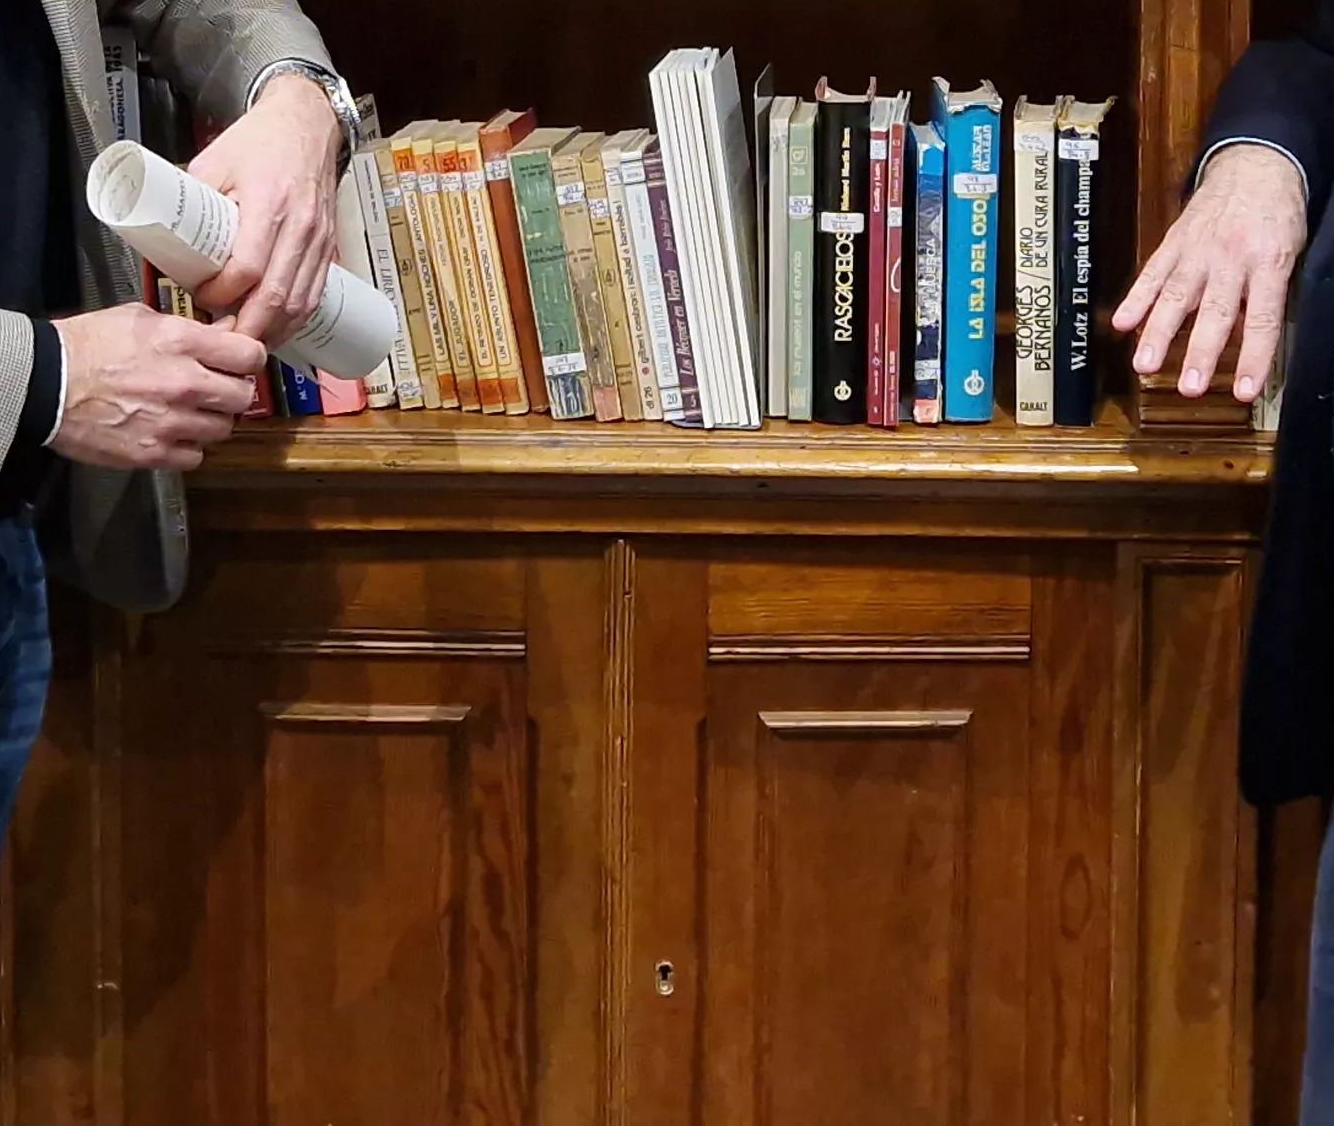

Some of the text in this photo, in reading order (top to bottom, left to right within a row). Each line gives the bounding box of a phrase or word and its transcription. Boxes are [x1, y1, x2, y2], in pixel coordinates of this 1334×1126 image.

[1074, 159, 1092, 216] champa
[1074, 218, 1090, 242] del
[414, 247, 431, 288] NOCHES
[968, 198, 987, 339] LA ISLA DEL OSO
[1033, 151, 1051, 371] BERNANOS DE UN CURA RURAL
[1073, 244, 1092, 283] espía
[422, 288, 436, 311] UNA
[1015, 226, 1033, 359] GEORGES DIARIO
[1073, 287, 1088, 304] El
[426, 309, 437, 319] Y
[428, 319, 441, 336] MIL
[431, 336, 445, 356] LAS
[1019, 401, 1048, 412] CARALT
